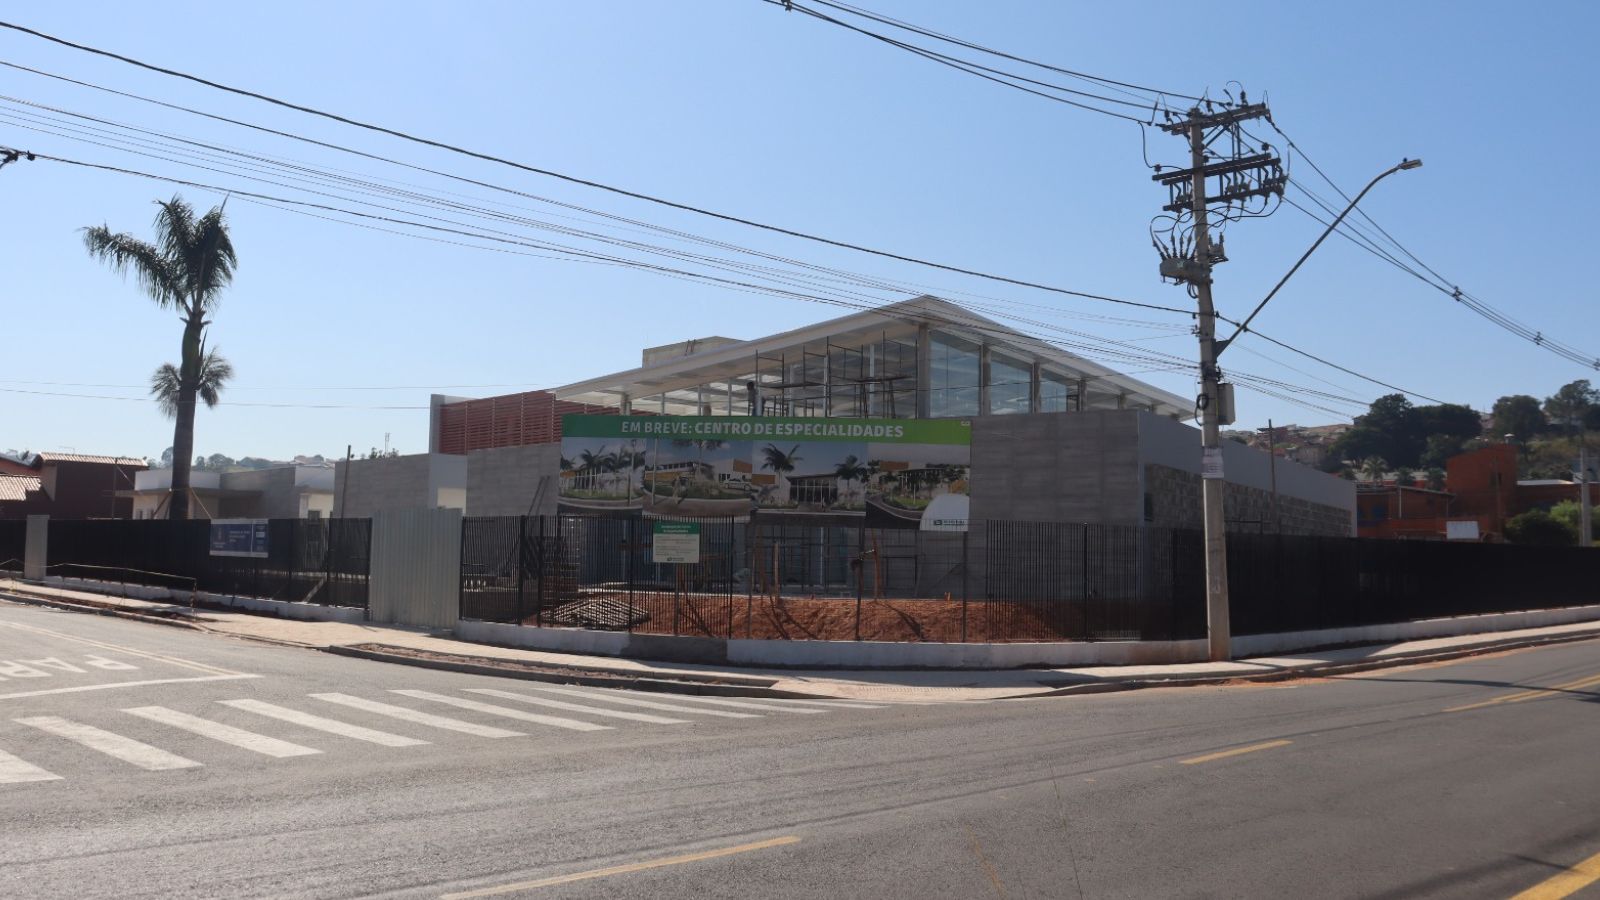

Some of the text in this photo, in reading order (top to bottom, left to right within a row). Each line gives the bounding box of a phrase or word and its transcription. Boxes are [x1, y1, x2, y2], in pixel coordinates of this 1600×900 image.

[621, 421, 904, 438] EM BREVE: CENTRO DE ESPECIALIDADES
[0, 654, 141, 681] PAR
